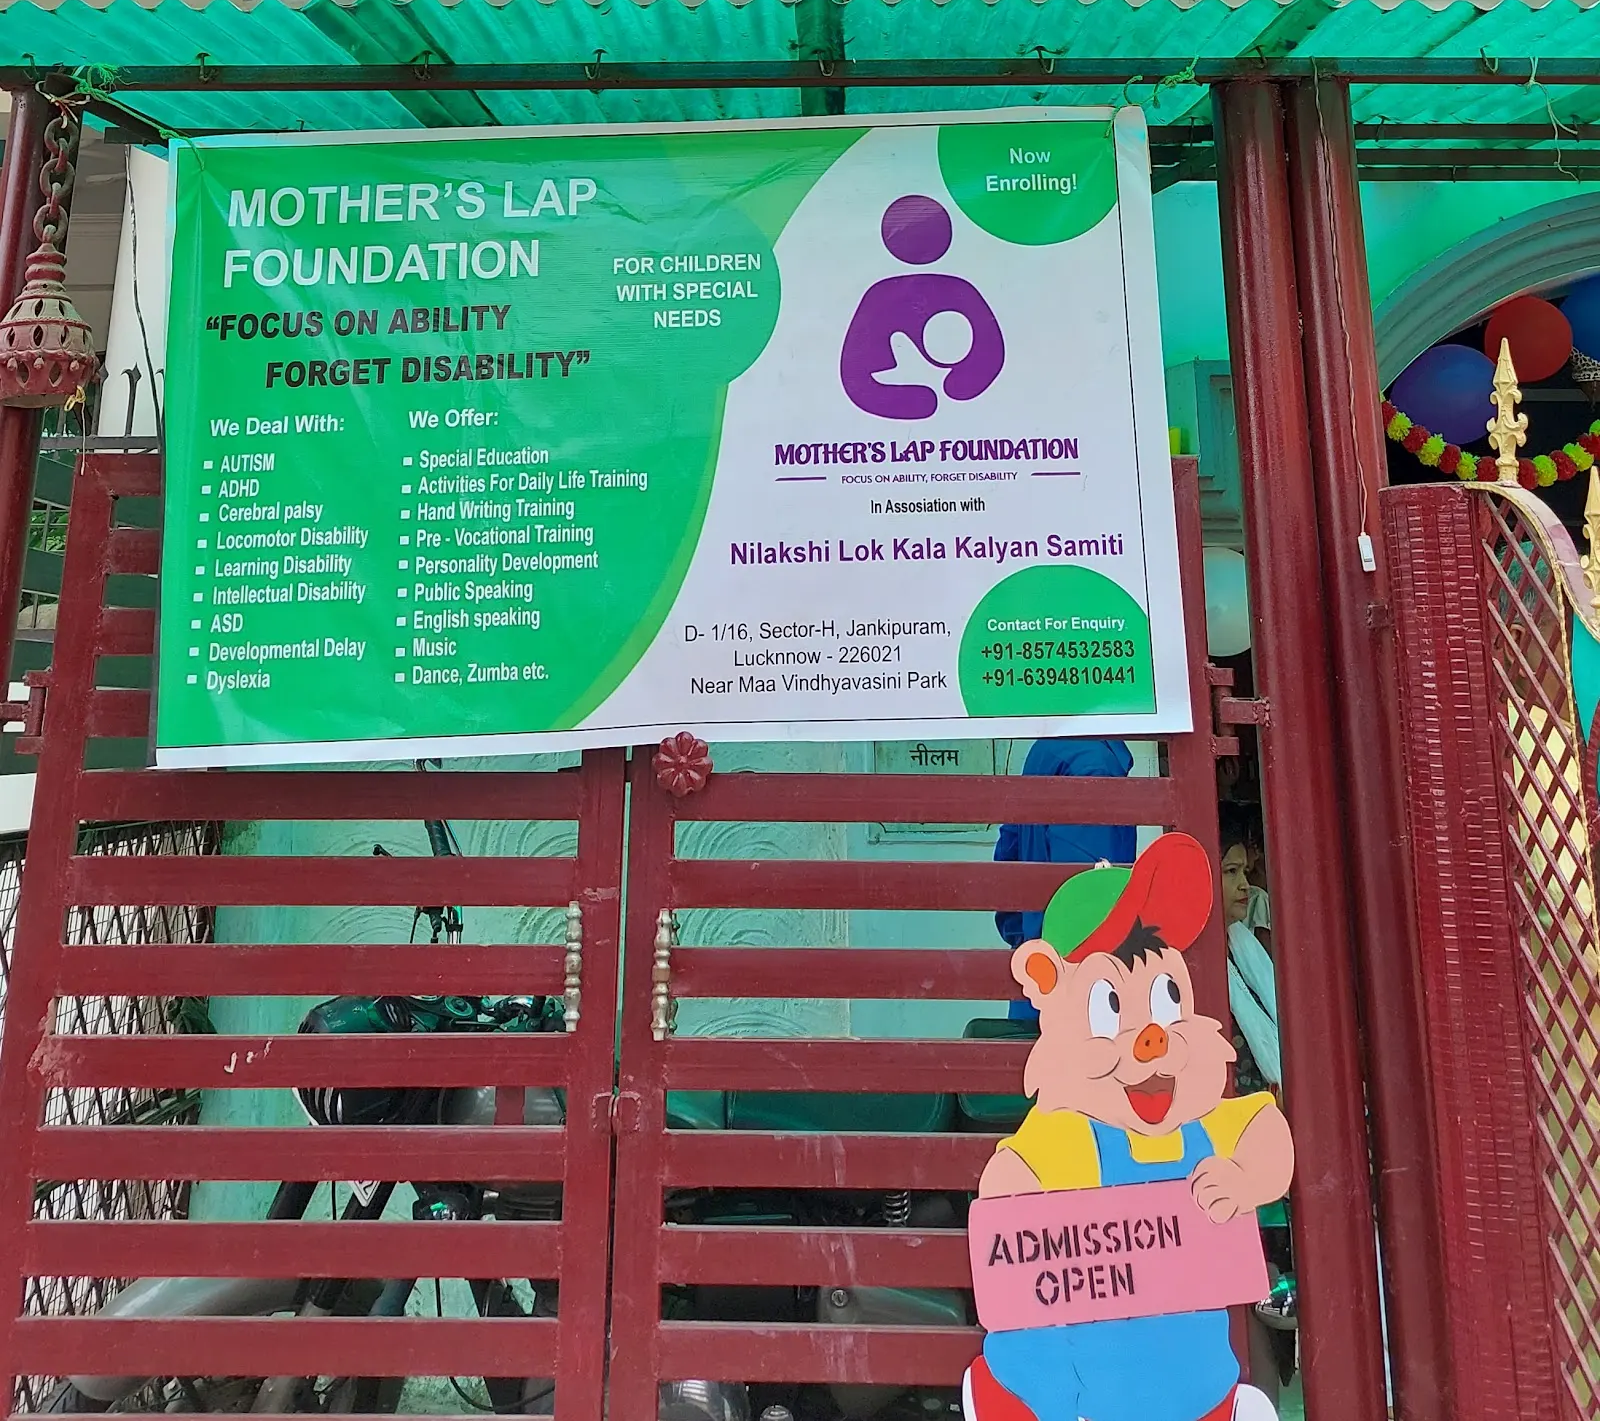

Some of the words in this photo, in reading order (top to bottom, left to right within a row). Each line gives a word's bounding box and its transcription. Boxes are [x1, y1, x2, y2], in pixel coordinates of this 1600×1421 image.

[1009, 148, 1050, 164] Now
[986, 173, 1078, 195] Enrolling!
[503, 178, 598, 219] LAP
[223, 239, 540, 289] FOUNDATION
[612, 256, 655, 275] FOR
[659, 253, 761, 274] CHILDREN
[616, 284, 668, 302] WITH
[672, 280, 758, 300] SPECIAL
[335, 309, 377, 335] ON
[388, 305, 512, 333] ABILITY
[653, 309, 722, 329] NEEDS
[265, 358, 391, 389] FORGET
[211, 419, 239, 436] We
[246, 416, 288, 435] Deal
[295, 414, 344, 433] With:
[409, 411, 439, 428] We
[445, 409, 498, 427] Offer:
[220, 453, 275, 473] AUTISM
[419, 449, 472, 471] Special
[477, 447, 549, 466] Education
[774, 443, 886, 465] MOTHER'S
[890, 440, 934, 462] LAP
[939, 438, 1079, 461] FOUNDATION
[218, 479, 259, 498] ADHD
[418, 476, 485, 494] Activities
[490, 474, 514, 492] For
[518, 472, 554, 494] Daily
[559, 471, 585, 489] Life
[589, 469, 648, 491] Training
[841, 475, 872, 484] FOCUS
[875, 475, 890, 484] ON
[892, 473, 928, 484] ABILITY,
[930, 473, 966, 482] FORGET
[968, 471, 1018, 482] DISABILITY
[219, 502, 280, 522] Cerebral
[284, 501, 323, 524] palsy
[417, 503, 455, 521] Hand
[460, 500, 511, 522] Writing
[516, 498, 574, 520] Training
[871, 500, 882, 513] In
[959, 497, 985, 512] with
[217, 530, 296, 550] Locomotor
[300, 526, 368, 549] Disability
[416, 529, 441, 548] Pre
[455, 526, 530, 546] Vocational
[535, 524, 593, 546] Training
[730, 539, 830, 566] Nilakshi
[838, 539, 884, 563] Lok
[893, 538, 947, 560] Kala
[955, 536, 1038, 563] Kalyan
[1046, 533, 1124, 557] Samiti
[215, 557, 279, 579] Learning
[283, 554, 352, 577] Disability
[415, 553, 497, 576] Personality
[502, 551, 598, 574] Development
[213, 583, 293, 605] Intellectual
[297, 581, 366, 604] Disability
[415, 582, 460, 602] Public
[465, 580, 533, 604] Speaking
[210, 614, 243, 633] ASD
[413, 609, 469, 634] English
[474, 607, 541, 631] speaking
[685, 625, 705, 642] D-
[711, 623, 753, 642] 1/16,
[759, 620, 840, 640] Sector-H,
[846, 619, 951, 640] Jankipuram,
[987, 619, 1041, 631] Contact
[1045, 618, 1068, 630] For
[209, 639, 319, 664] Developmental
[324, 637, 366, 661] Delay
[413, 637, 456, 657] Music
[734, 649, 821, 666] Lucknnow
[838, 645, 902, 663] 226021
[982, 640, 1135, 660] +91-8574532583
[206, 669, 270, 694] Dyslexia
[413, 665, 462, 686] Dance,
[467, 662, 518, 682] Zumba
[523, 662, 548, 680] etc.
[691, 677, 733, 694] Near
[739, 676, 776, 693] Maa
[782, 672, 902, 695] Vindhyavasini
[907, 671, 947, 689] Park
[982, 666, 1135, 686] +91-6394810441
[909, 743, 959, 766] नीलम
[989, 1216, 1182, 1266] ADMISSION
[1035, 1263, 1135, 1305] OPEN
